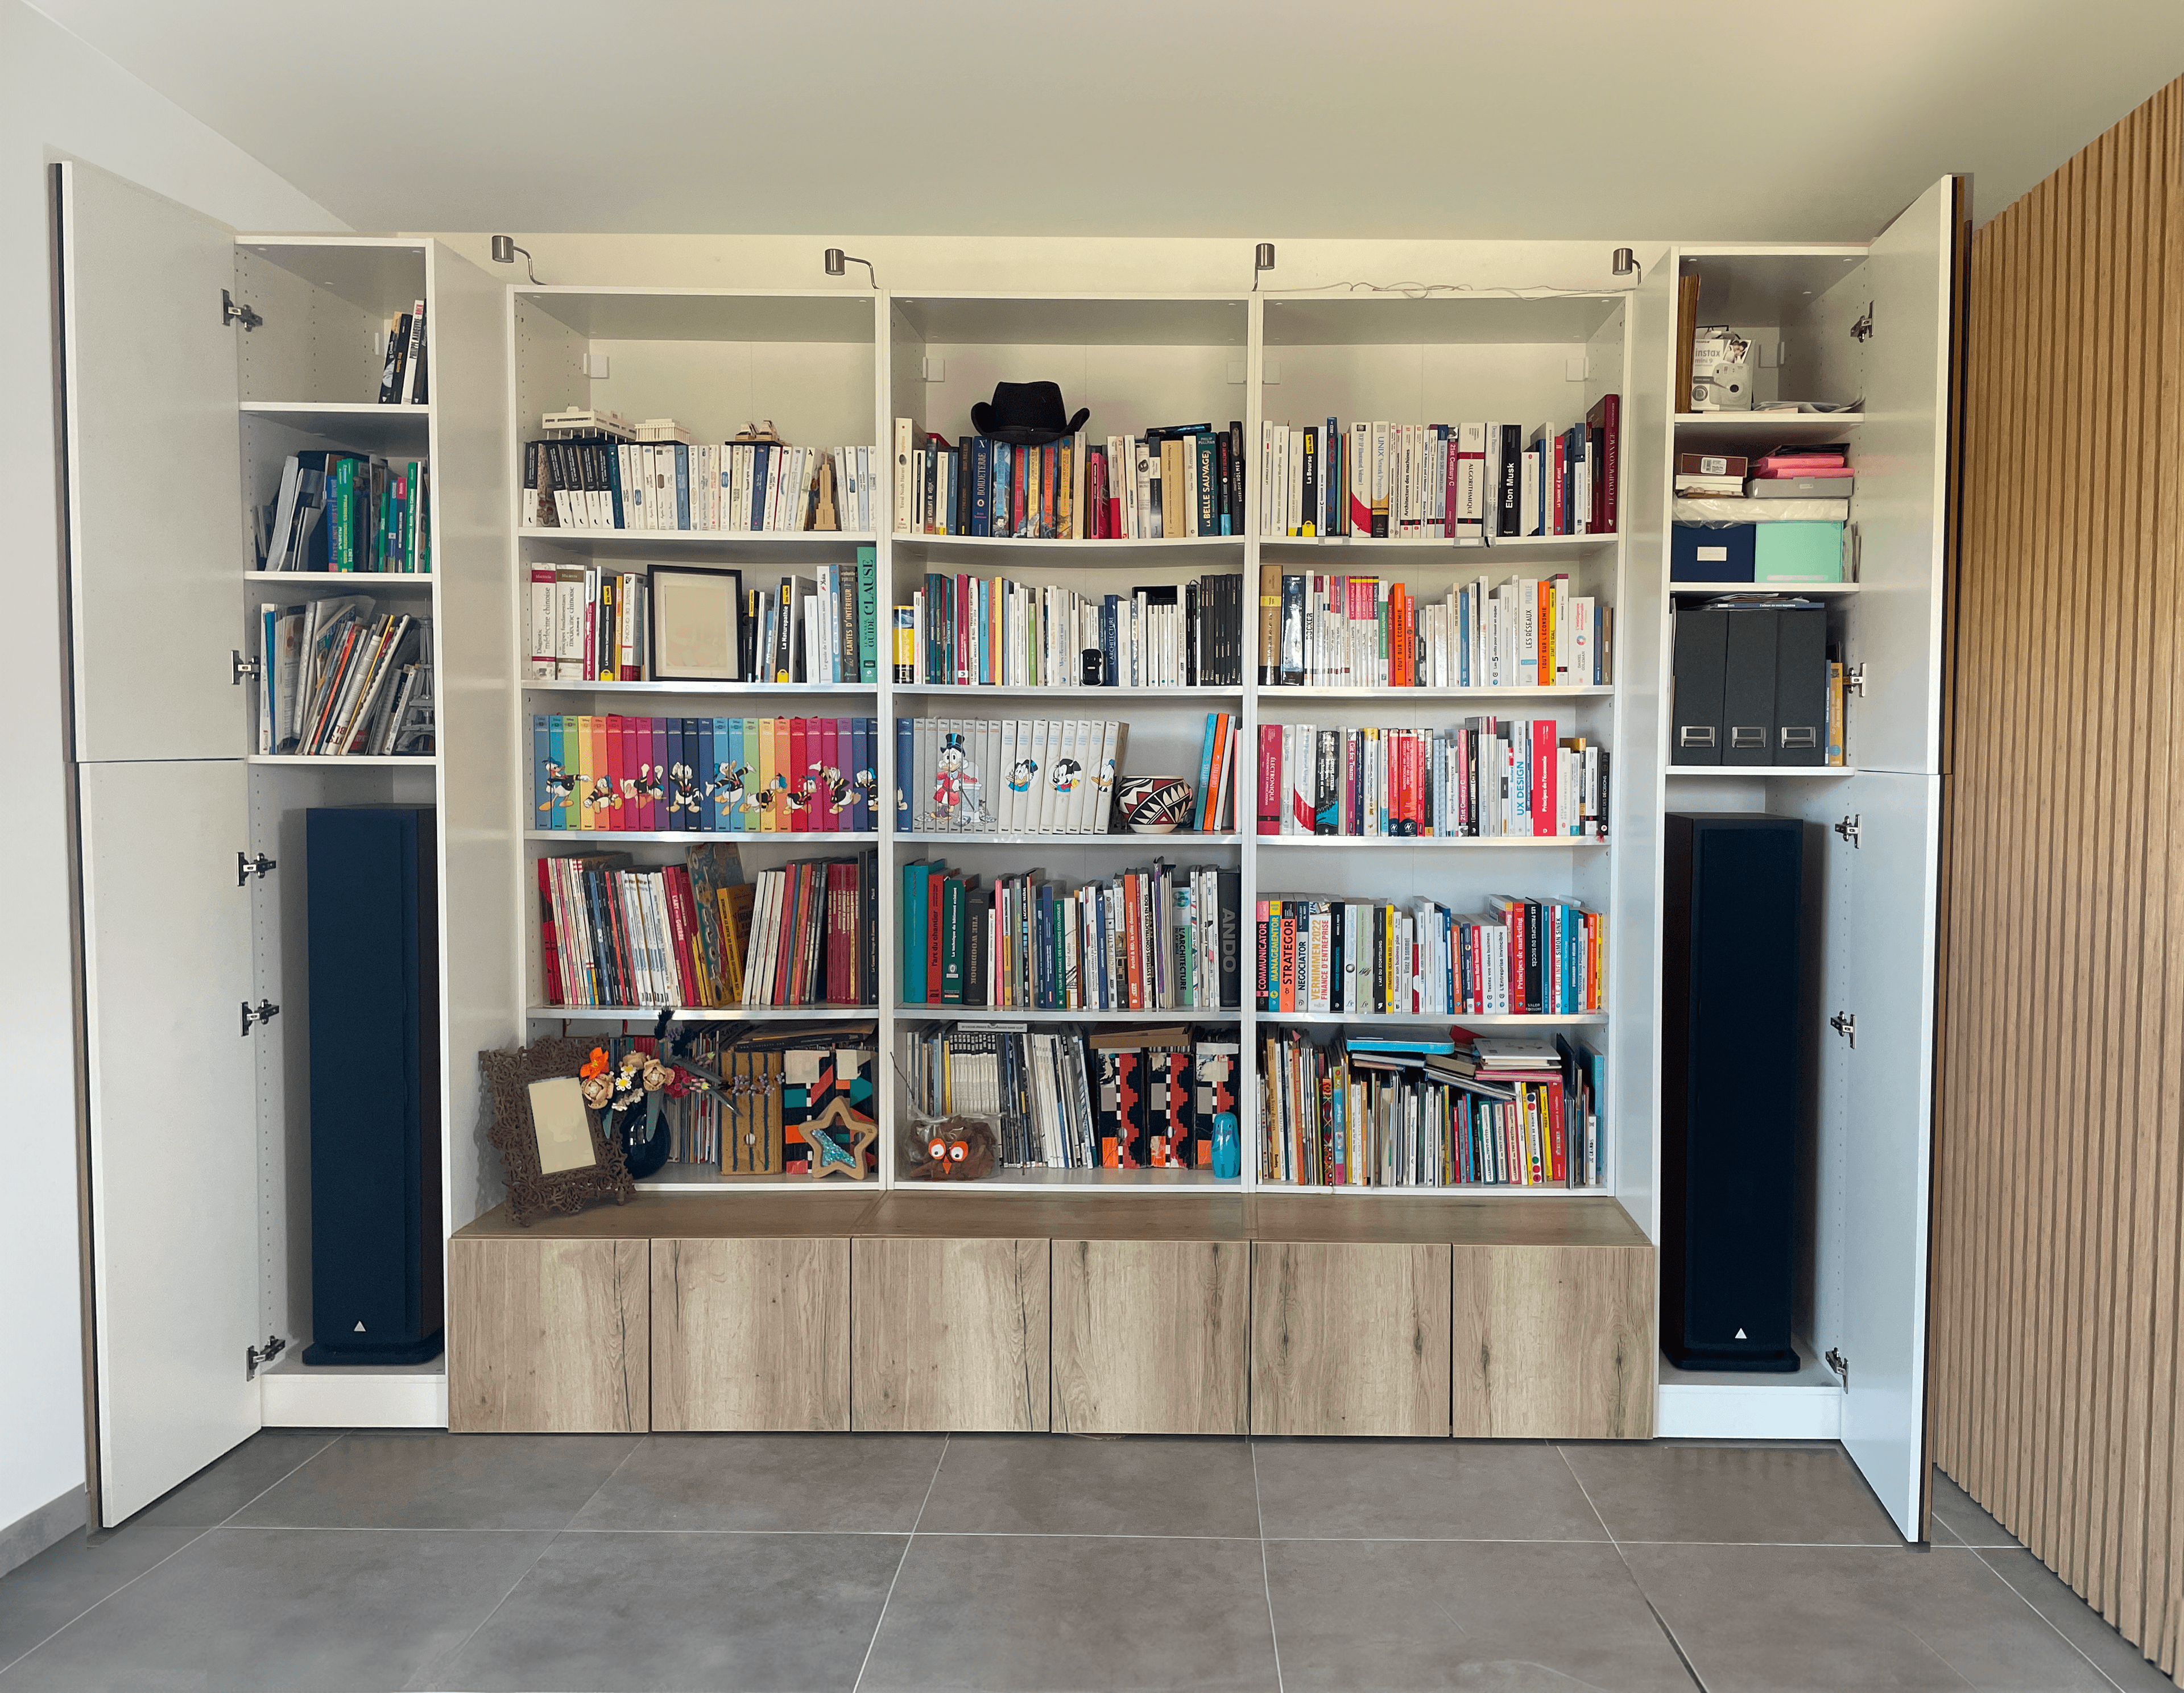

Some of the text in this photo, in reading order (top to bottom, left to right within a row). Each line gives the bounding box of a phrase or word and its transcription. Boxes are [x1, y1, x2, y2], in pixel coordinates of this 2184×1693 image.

[1695, 348, 1720, 357] instax
[977, 452, 986, 495] BORDETERRE
[1202, 453, 1210, 492] SAUVAGE
[1202, 494, 1211, 519] BELLE
[1608, 496, 1615, 504] LE
[843, 589, 852, 627] D'INTÉRIEUR
[863, 558, 874, 615] CLAUSE
[1516, 802, 1524, 816] UX
[1222, 907, 1236, 973] ANDO
[1258, 923, 1267, 990] COMMUNICATOR
[1283, 920, 1293, 985] STRATEGOR
[1311, 920, 1321, 1000] VERNIMMEN 2022
[1297, 941, 1306, 991] NEGOCIATOR
